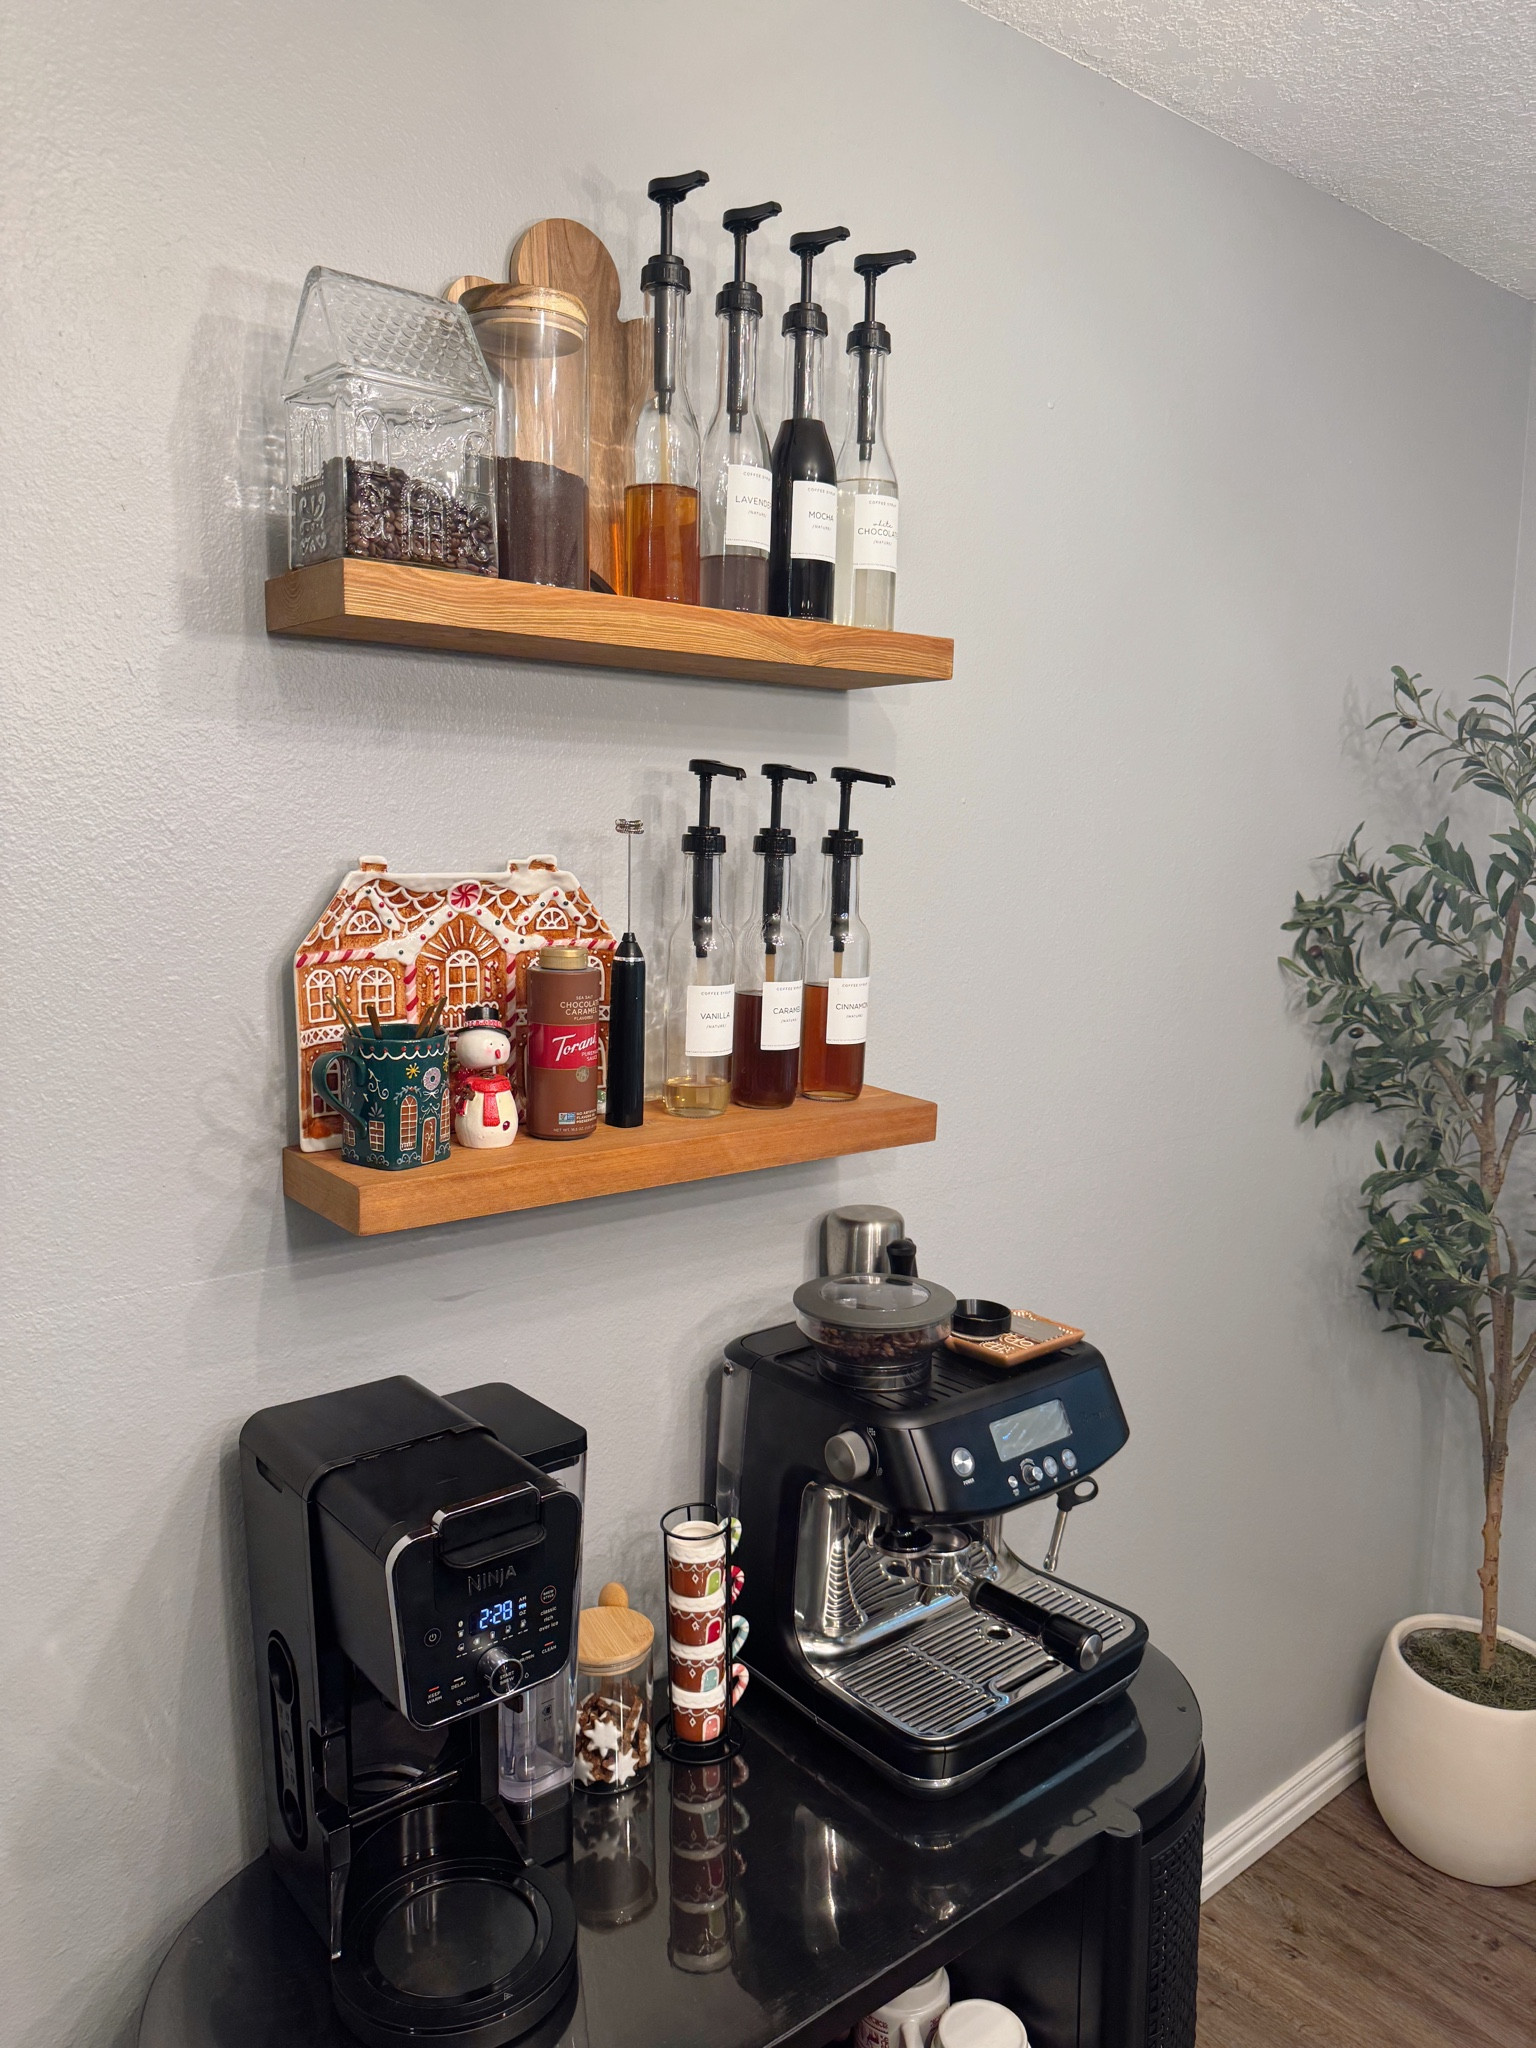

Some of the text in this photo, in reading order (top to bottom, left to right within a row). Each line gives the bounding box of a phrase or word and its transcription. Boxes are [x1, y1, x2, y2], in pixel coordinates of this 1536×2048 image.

[808, 511, 834, 520] MOCHA
[566, 1007, 597, 1015] CARAMEL
[700, 1012, 730, 1020] VANILLA
[552, 1030, 597, 1061] Torani
[468, 1566, 517, 1596] NINJA
[480, 1600, 512, 1630] 2:28
[540, 1606, 557, 1616] classic
[539, 1624, 550, 1632] over
[541, 1645, 557, 1654] CLEAN
[500, 1670, 515, 1680] START
[451, 1680, 467, 1690] DELAY
[428, 1690, 441, 1699] KEEP
[463, 1693, 480, 1703] closed
[426, 1695, 443, 1705] WARM
